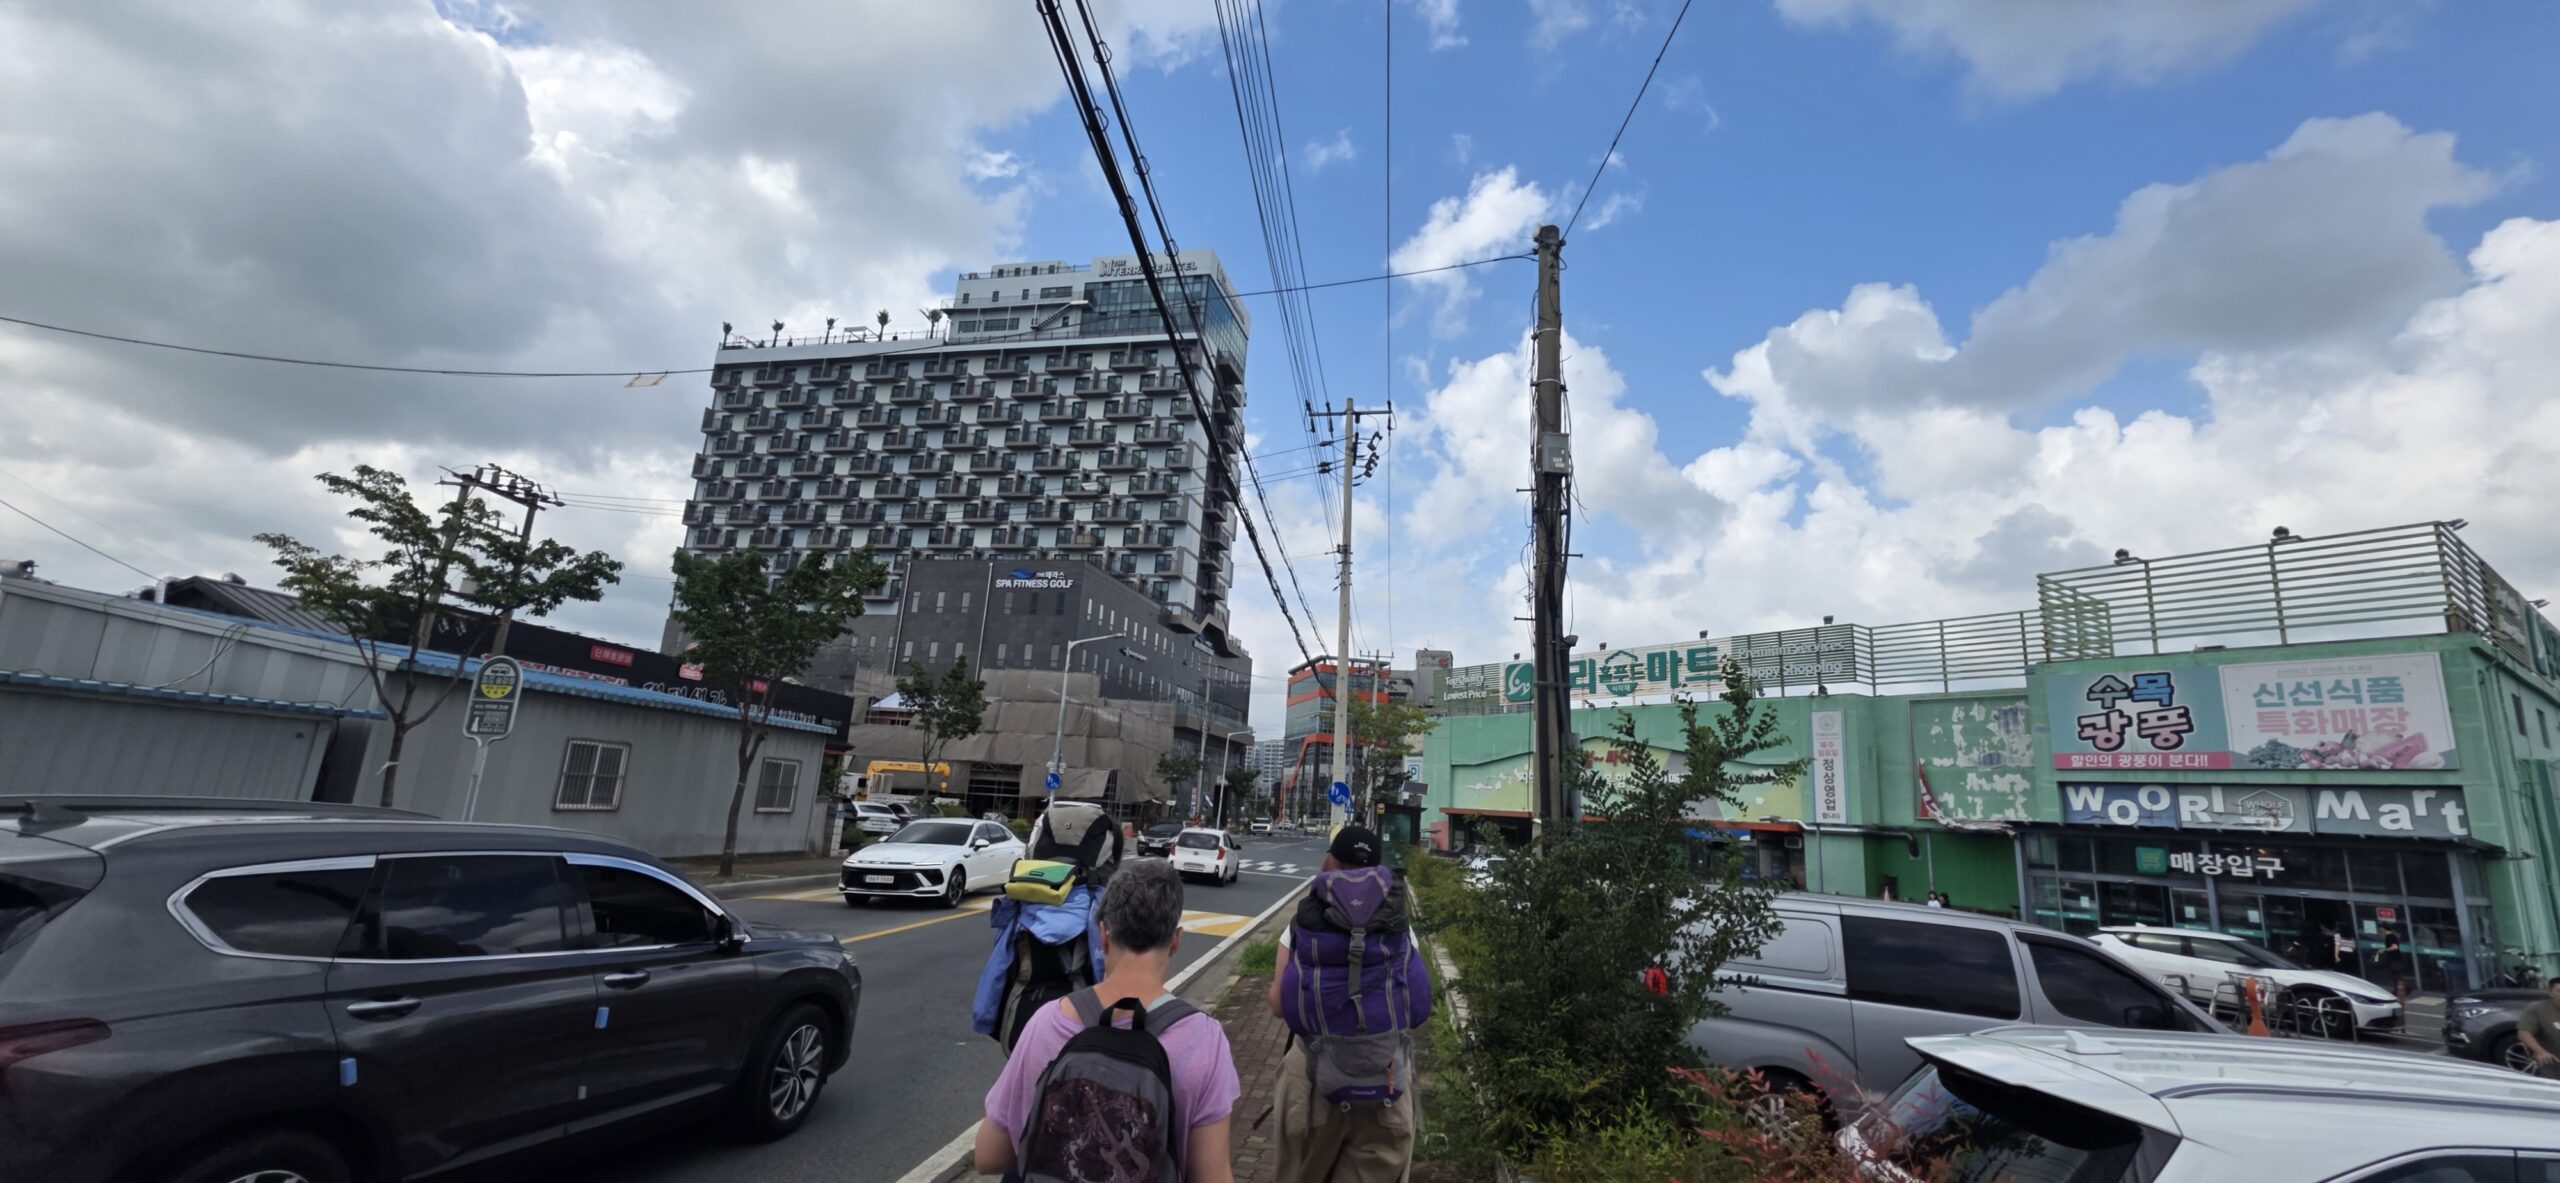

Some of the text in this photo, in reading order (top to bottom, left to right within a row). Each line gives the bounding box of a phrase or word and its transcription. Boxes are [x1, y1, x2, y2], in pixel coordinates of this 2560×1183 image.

[1112, 259, 1127, 267] THE
[1112, 264, 1163, 277] TERRAE
[995, 579, 1074, 589] SPA FITNESS GOLF
[1739, 641, 1845, 659] Premium Services
[1647, 646, 1722, 689] 마트
[1782, 660, 1843, 677] Shopping
[1445, 673, 1485, 687] Top Quality
[2086, 672, 2174, 709] 수목
[1443, 689, 1487, 701] Lowest Price
[2253, 676, 2405, 708] 신선식품
[2077, 706, 2195, 751] 광풍
[2256, 707, 2410, 736] 특화매장
[2071, 753, 2208, 767] 할인의 광풍이 분다!!
[1823, 759, 1836, 811] 정상영업
[2066, 785, 2468, 836] WOORI Mart
[2170, 852, 2285, 879] 매장입구
